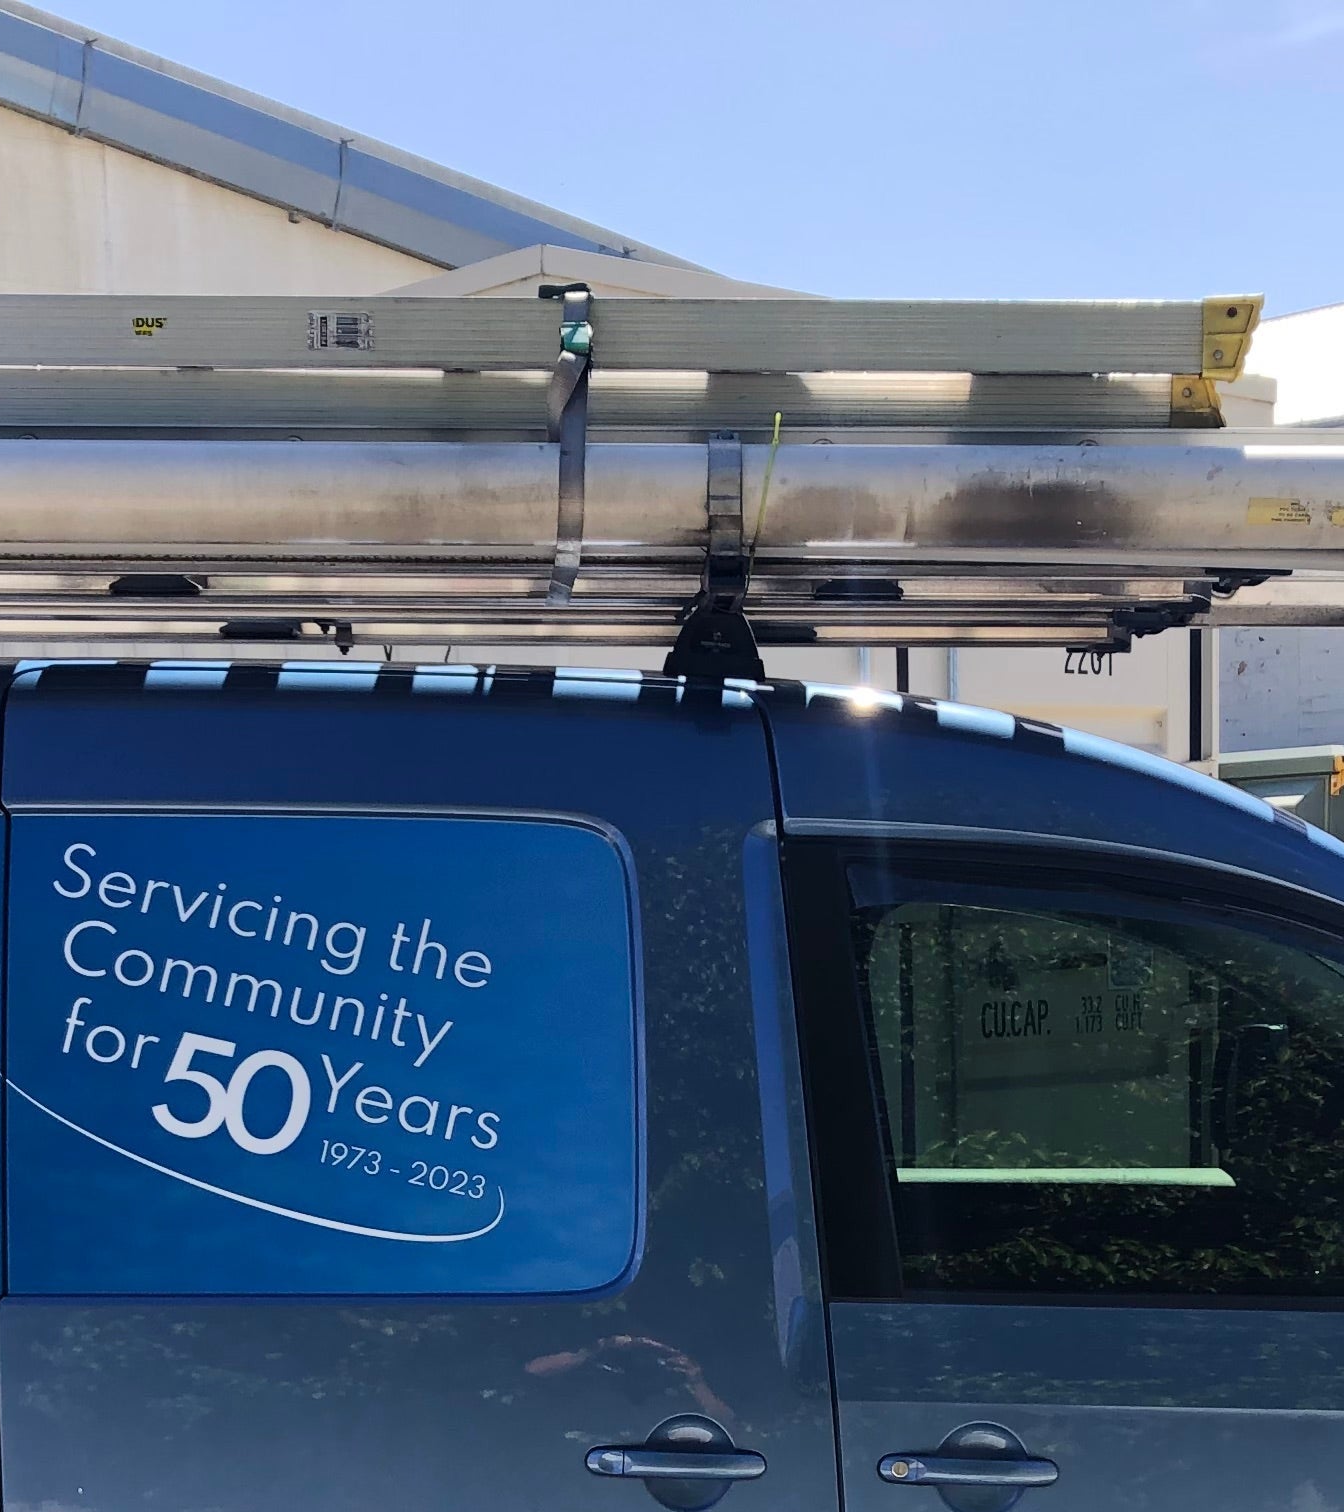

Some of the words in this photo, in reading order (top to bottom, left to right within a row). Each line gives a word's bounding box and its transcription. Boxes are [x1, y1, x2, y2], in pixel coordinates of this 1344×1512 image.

[53, 843, 366, 975] Servicing
[389, 917, 492, 988] the
[63, 920, 454, 1067] Community
[62, 997, 160, 1069] for
[151, 1031, 312, 1155] 50
[321, 1053, 501, 1150] Years
[320, 1139, 381, 1175] 1973
[408, 1161, 486, 1200] 2023
